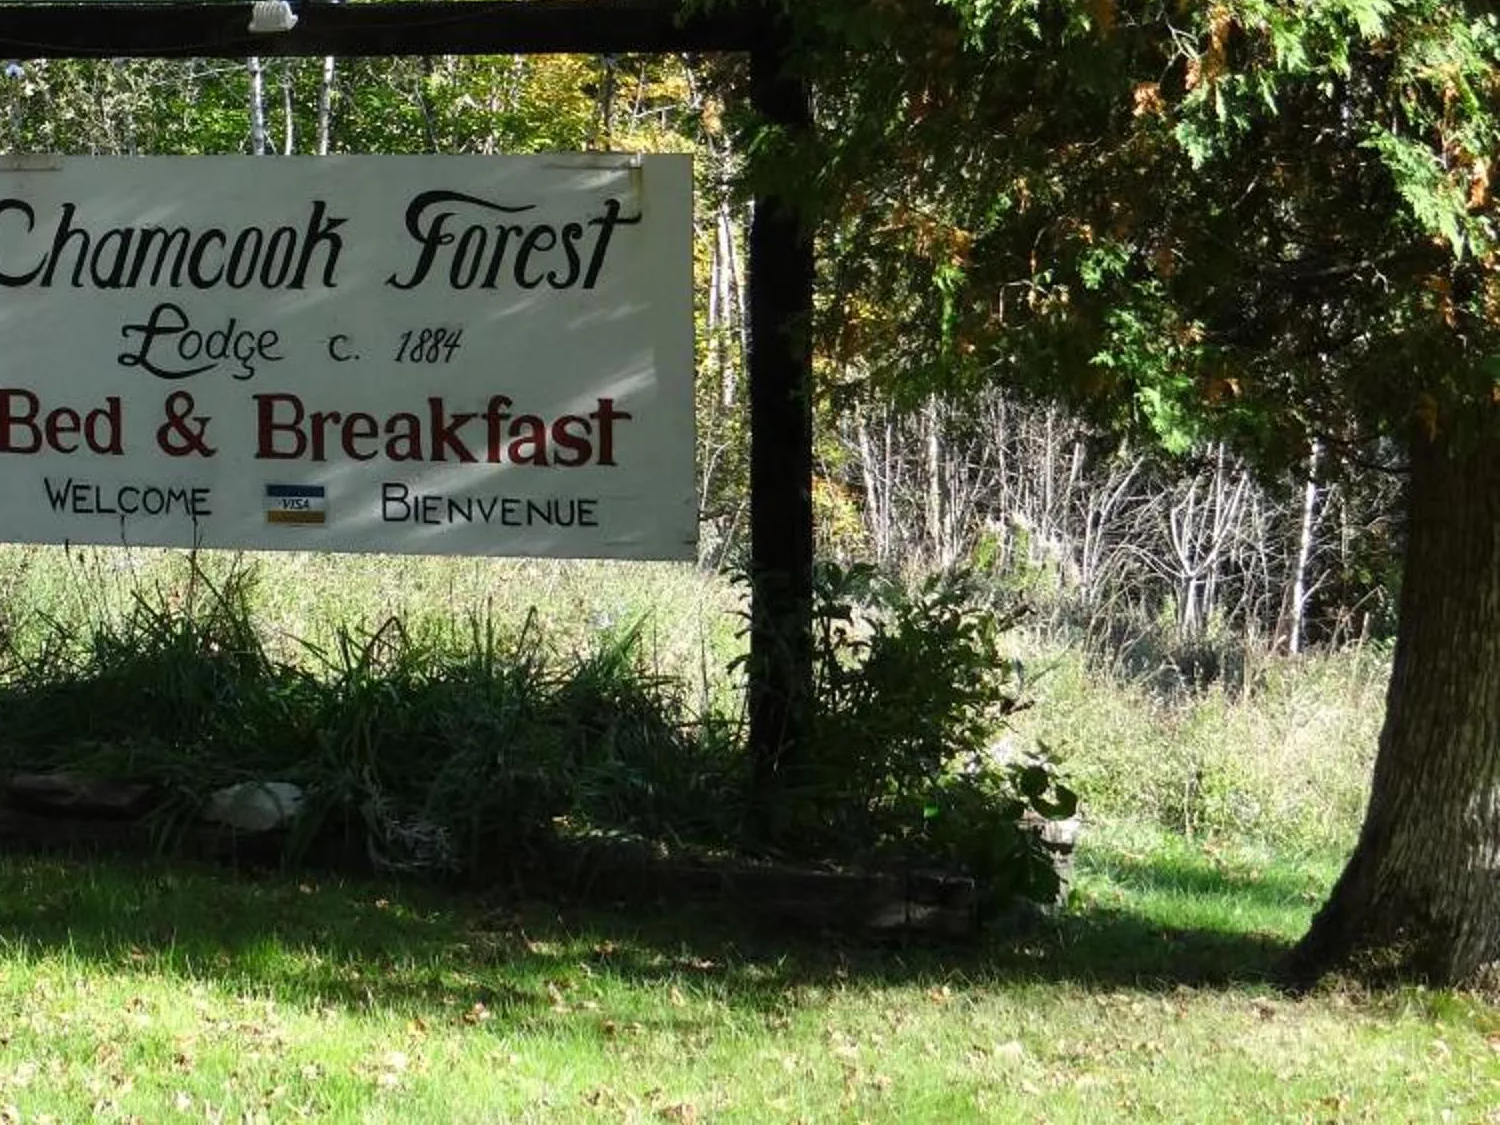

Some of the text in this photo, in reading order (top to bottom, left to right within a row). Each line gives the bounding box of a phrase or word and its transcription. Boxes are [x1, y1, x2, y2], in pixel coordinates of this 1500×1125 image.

[385, 189, 643, 290] Forest
[117, 303, 284, 380] Lodge
[393, 327, 463, 365] 1884
[156, 391, 218, 458] &
[253, 393, 632, 467] Breakfast
[43, 477, 213, 517] WELCOME
[282, 498, 309, 510] VISA
[380, 483, 599, 528] BIENVENUE
